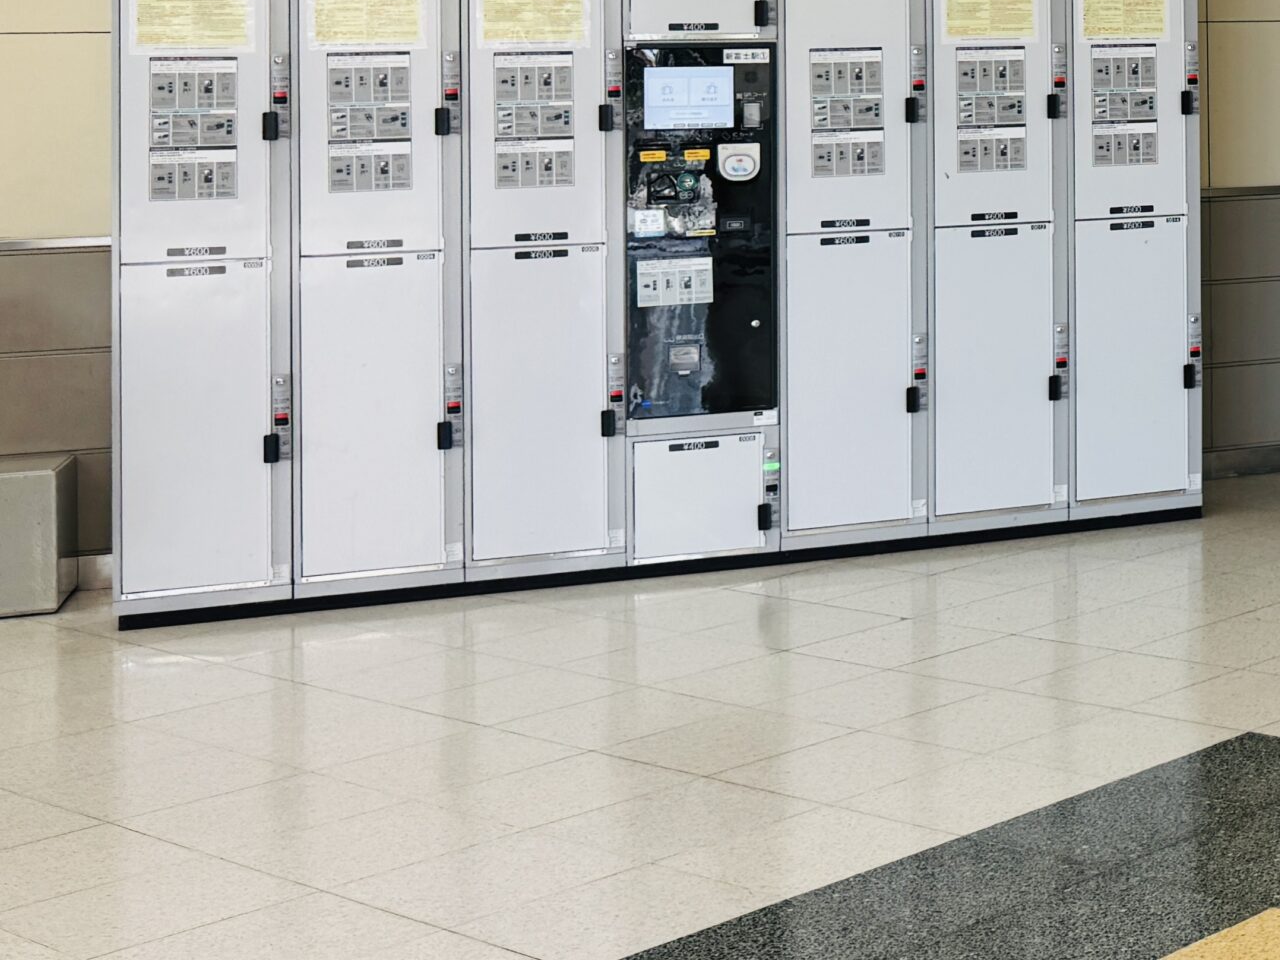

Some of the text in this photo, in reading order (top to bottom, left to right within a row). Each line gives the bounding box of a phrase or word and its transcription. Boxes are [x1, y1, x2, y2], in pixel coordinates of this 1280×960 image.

[683, 23, 706, 32] ¥400
[835, 219, 857, 228] ¥600
[530, 232, 554, 241] ¥600
[985, 228, 1006, 237] ¥600
[362, 239, 388, 249] ¥600
[835, 236, 857, 245] ¥600
[184, 247, 210, 256] ¥600
[531, 249, 553, 259] ¥600
[362, 257, 388, 267] ¥600
[184, 266, 209, 275] ¥600
[683, 441, 706, 451] ¥400
